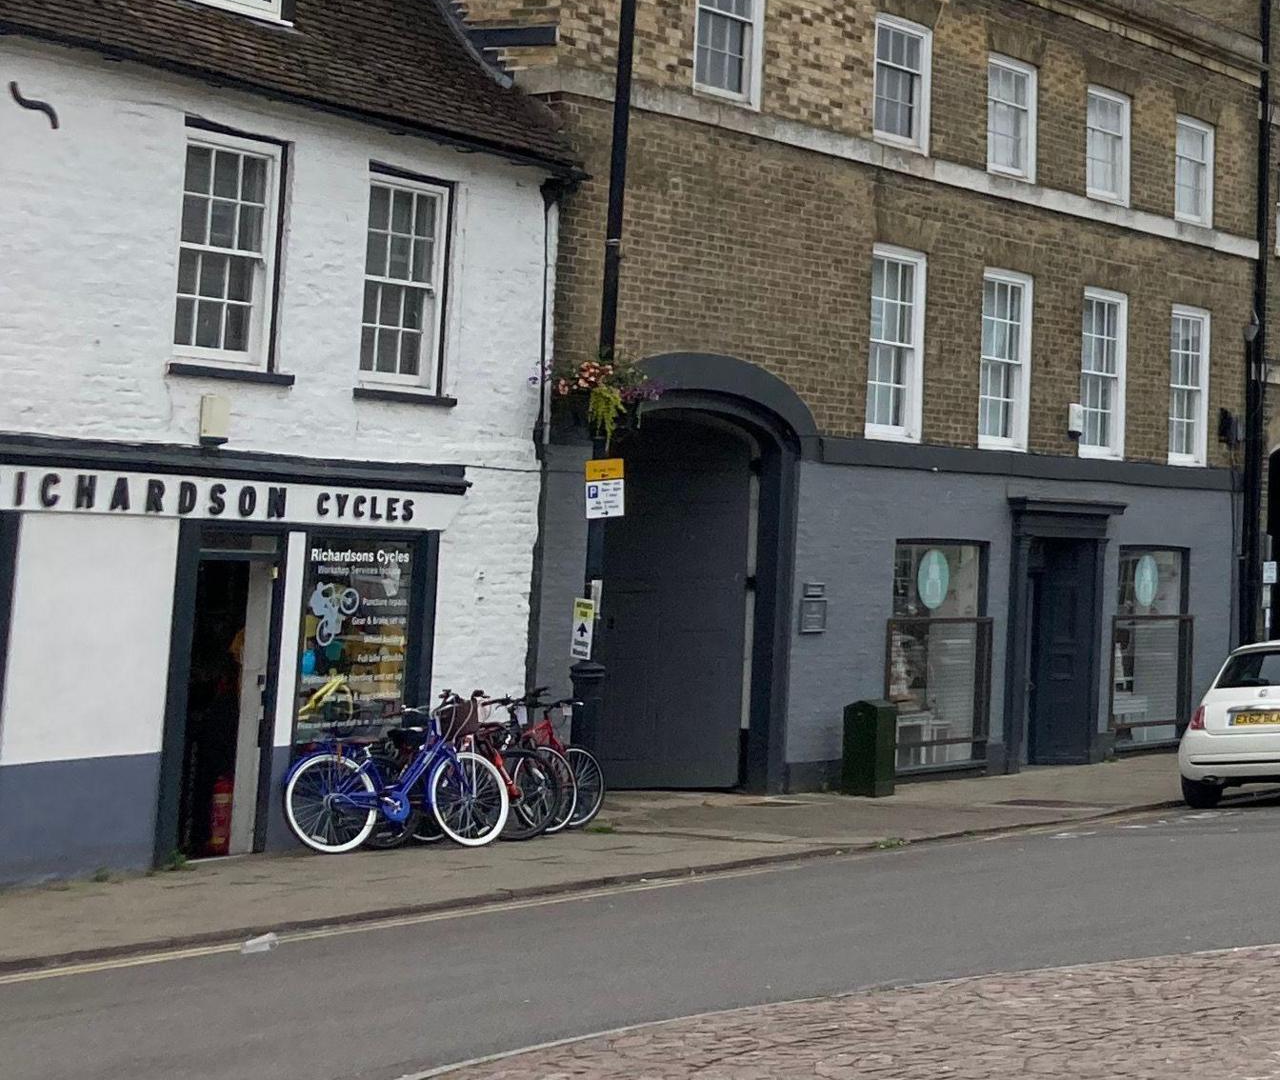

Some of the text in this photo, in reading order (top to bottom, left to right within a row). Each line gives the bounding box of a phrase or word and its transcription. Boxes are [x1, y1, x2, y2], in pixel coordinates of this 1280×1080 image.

[0, 471, 415, 523] ICHARDSON CYCLES
[310, 548, 410, 564] Richardsons Cycles
[1236, 712, 1262, 725] EX62
